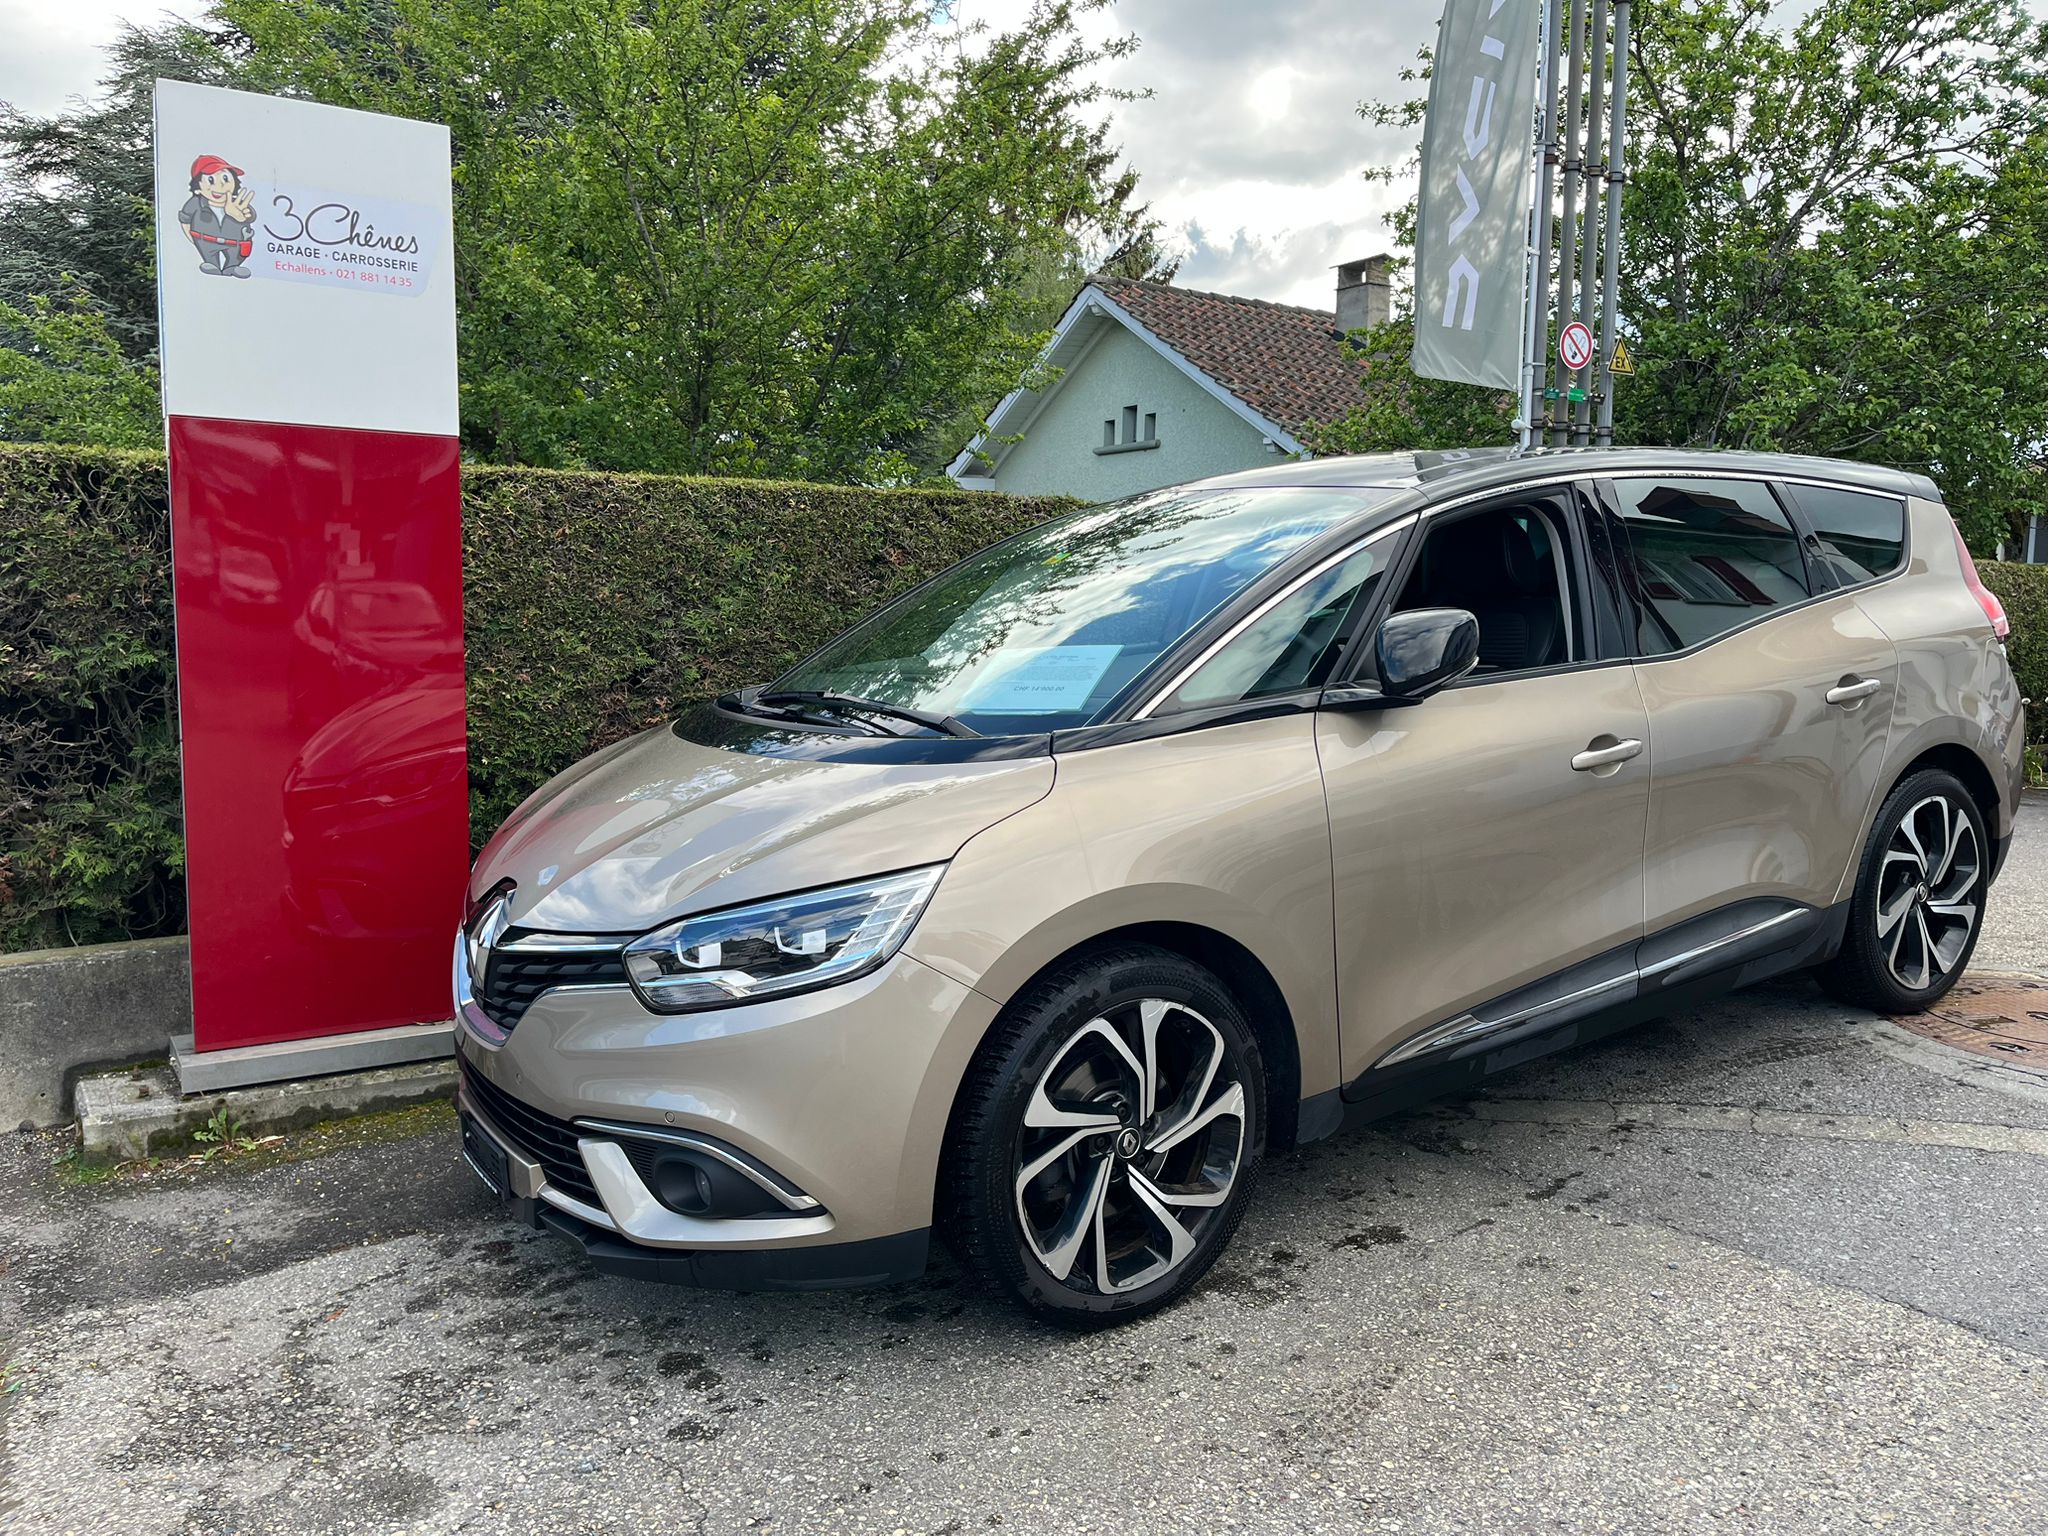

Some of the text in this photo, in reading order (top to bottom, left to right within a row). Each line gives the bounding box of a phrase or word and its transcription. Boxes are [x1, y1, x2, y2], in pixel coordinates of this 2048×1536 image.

[264, 195, 418, 253] 3 Chênes
[267, 242, 418, 272] GARAGE CARROSSERIE
[275, 261, 412, 287] Echallens 021 881 14 35
[1616, 356, 1626, 369] EX
